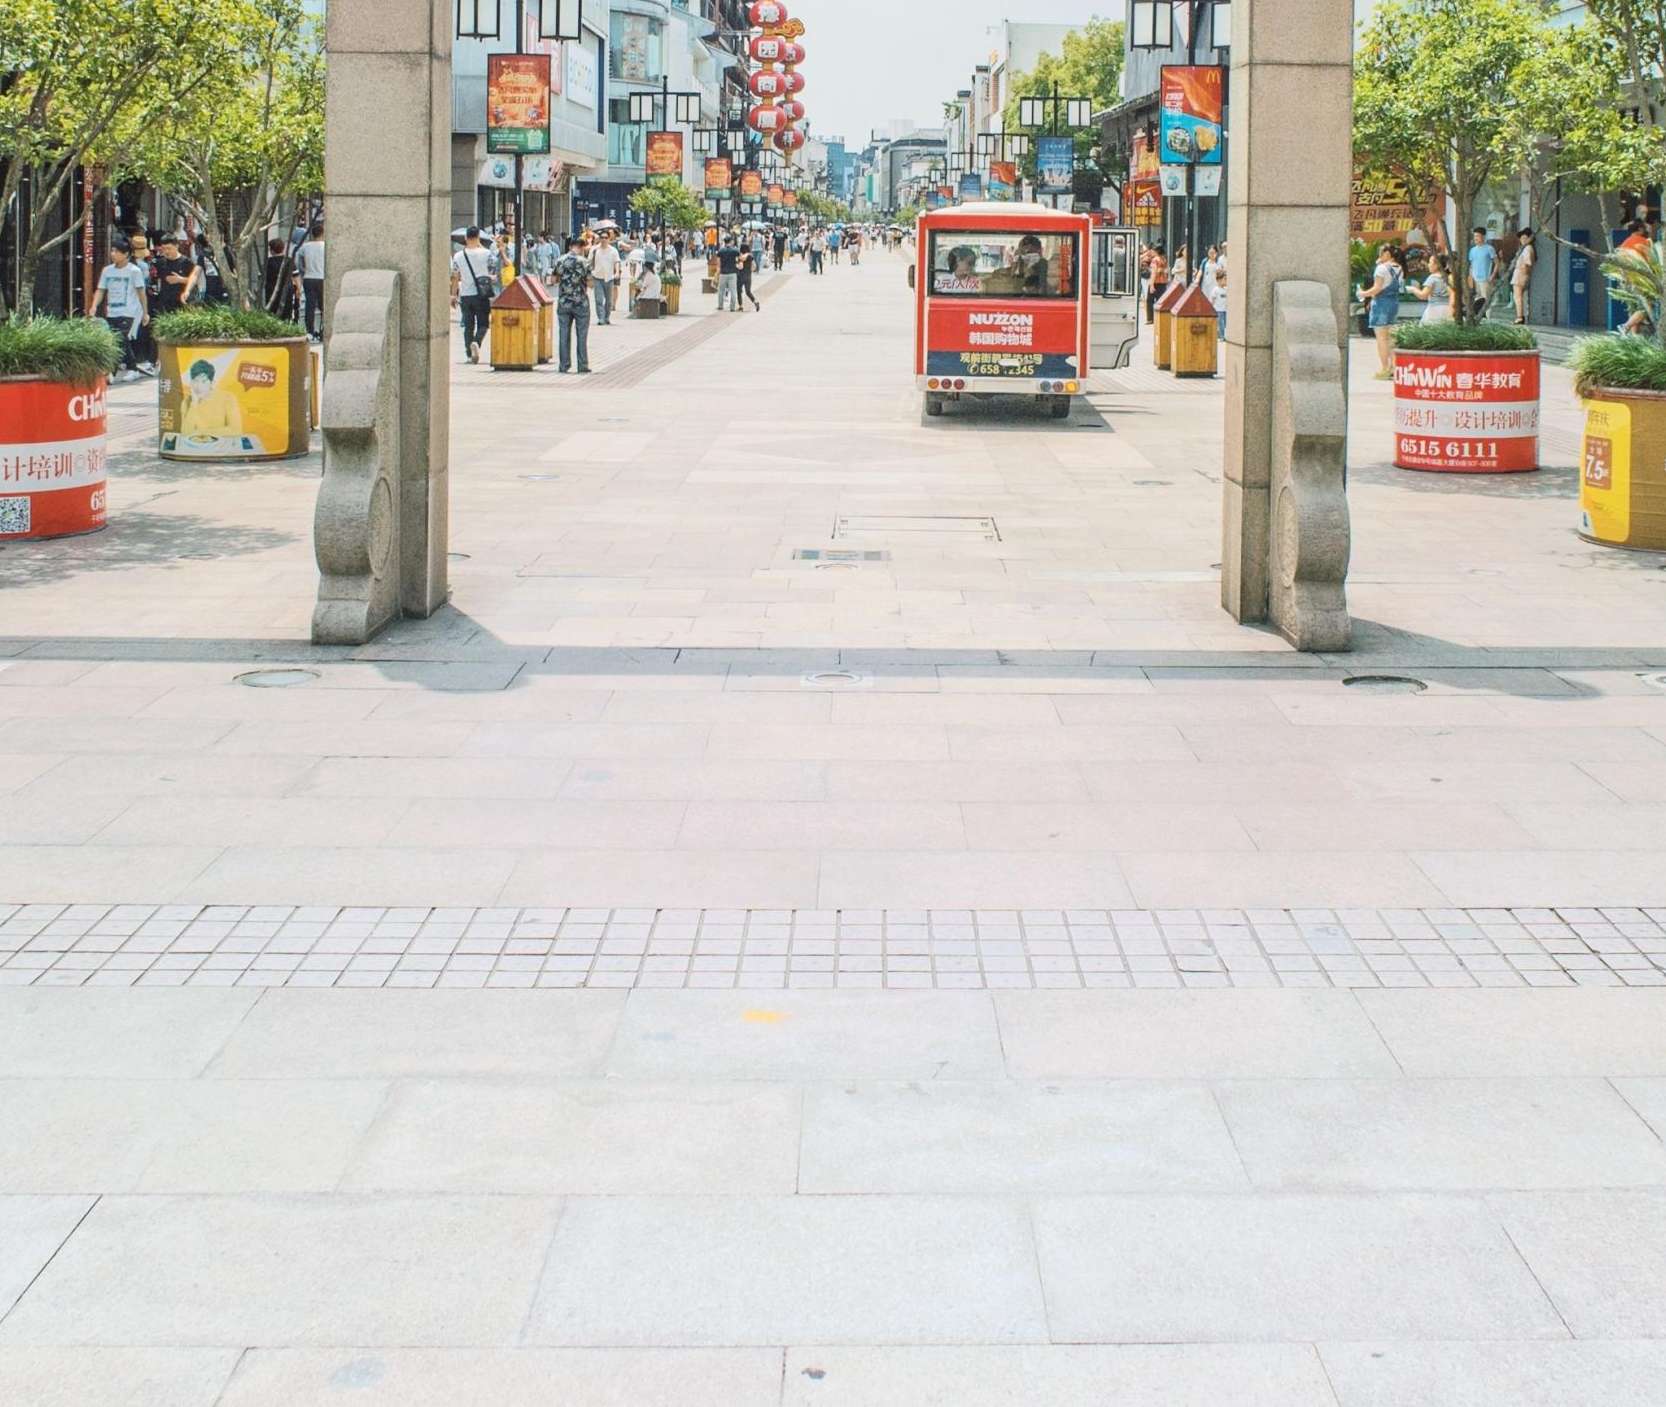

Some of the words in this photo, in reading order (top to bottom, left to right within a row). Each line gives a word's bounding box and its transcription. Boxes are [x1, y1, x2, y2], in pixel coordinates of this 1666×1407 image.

[968, 332, 1033, 346] 韩国购物城
[1456, 372, 1521, 389] 春华教育
[1454, 410, 1521, 430] 设计培训
[1400, 438, 1440, 456] 6515
[1445, 442, 1499, 458] 6111
